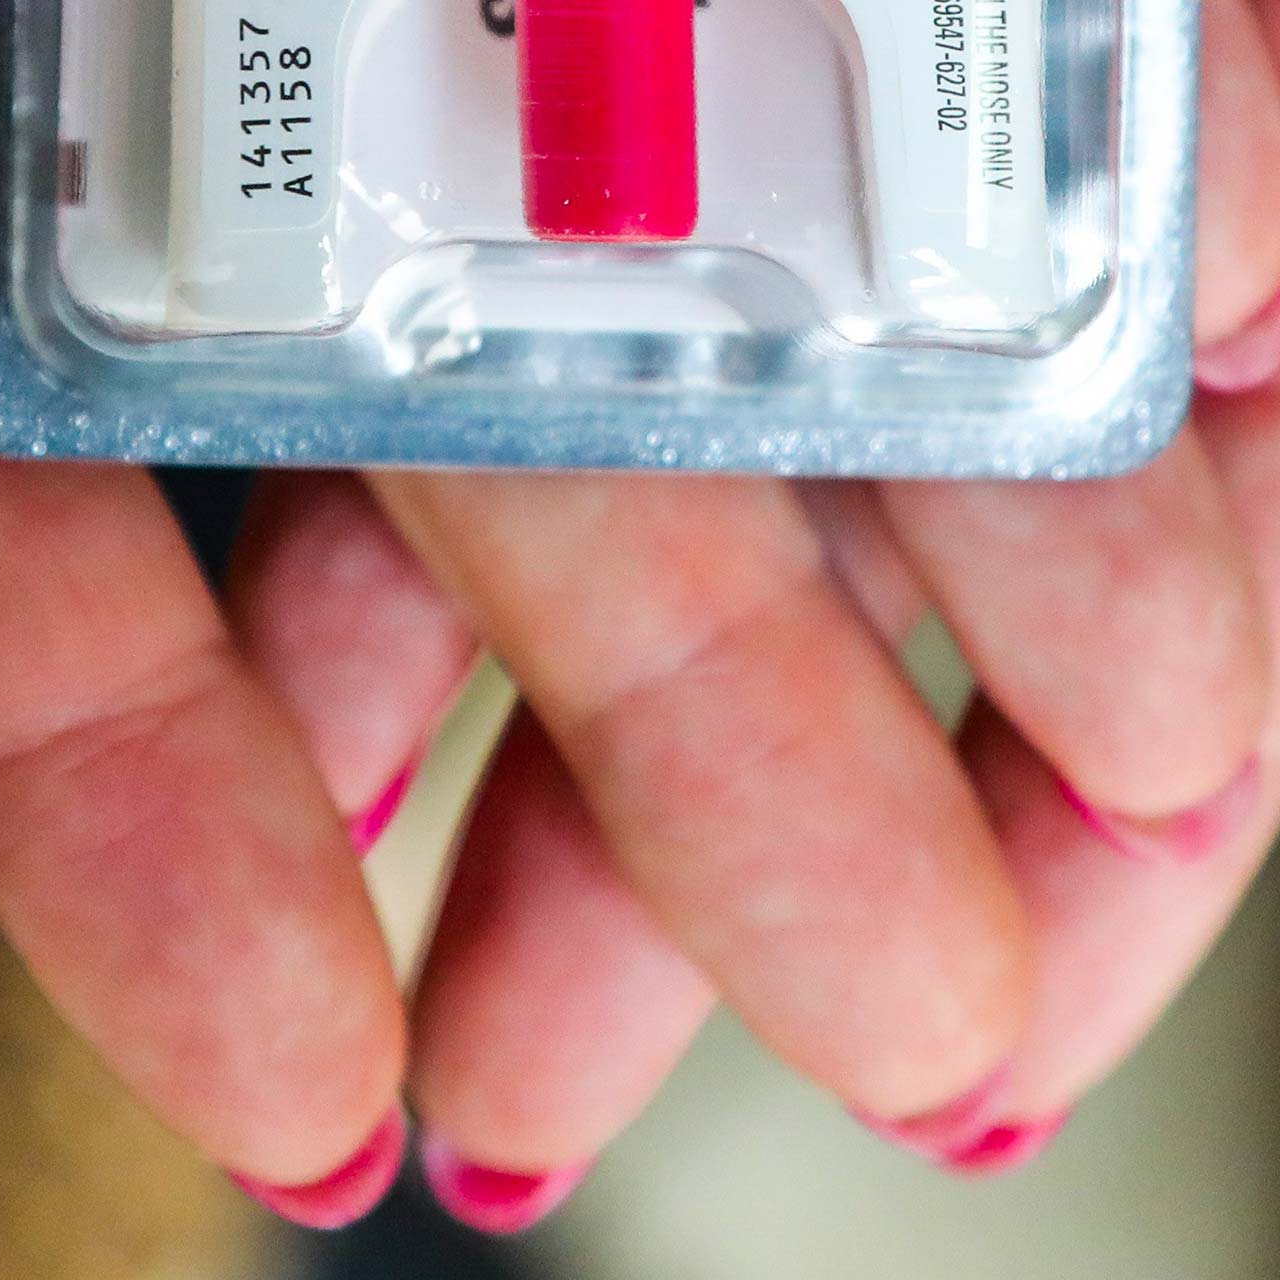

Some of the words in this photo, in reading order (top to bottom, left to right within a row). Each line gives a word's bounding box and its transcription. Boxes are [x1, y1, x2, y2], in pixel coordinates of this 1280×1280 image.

[974, 10, 1008, 55] THE
[238, 17, 273, 199] 141357
[278, 45, 314, 198] A1158
[976, 61, 1011, 125] NOSE
[980, 130, 1014, 191] ONLY
